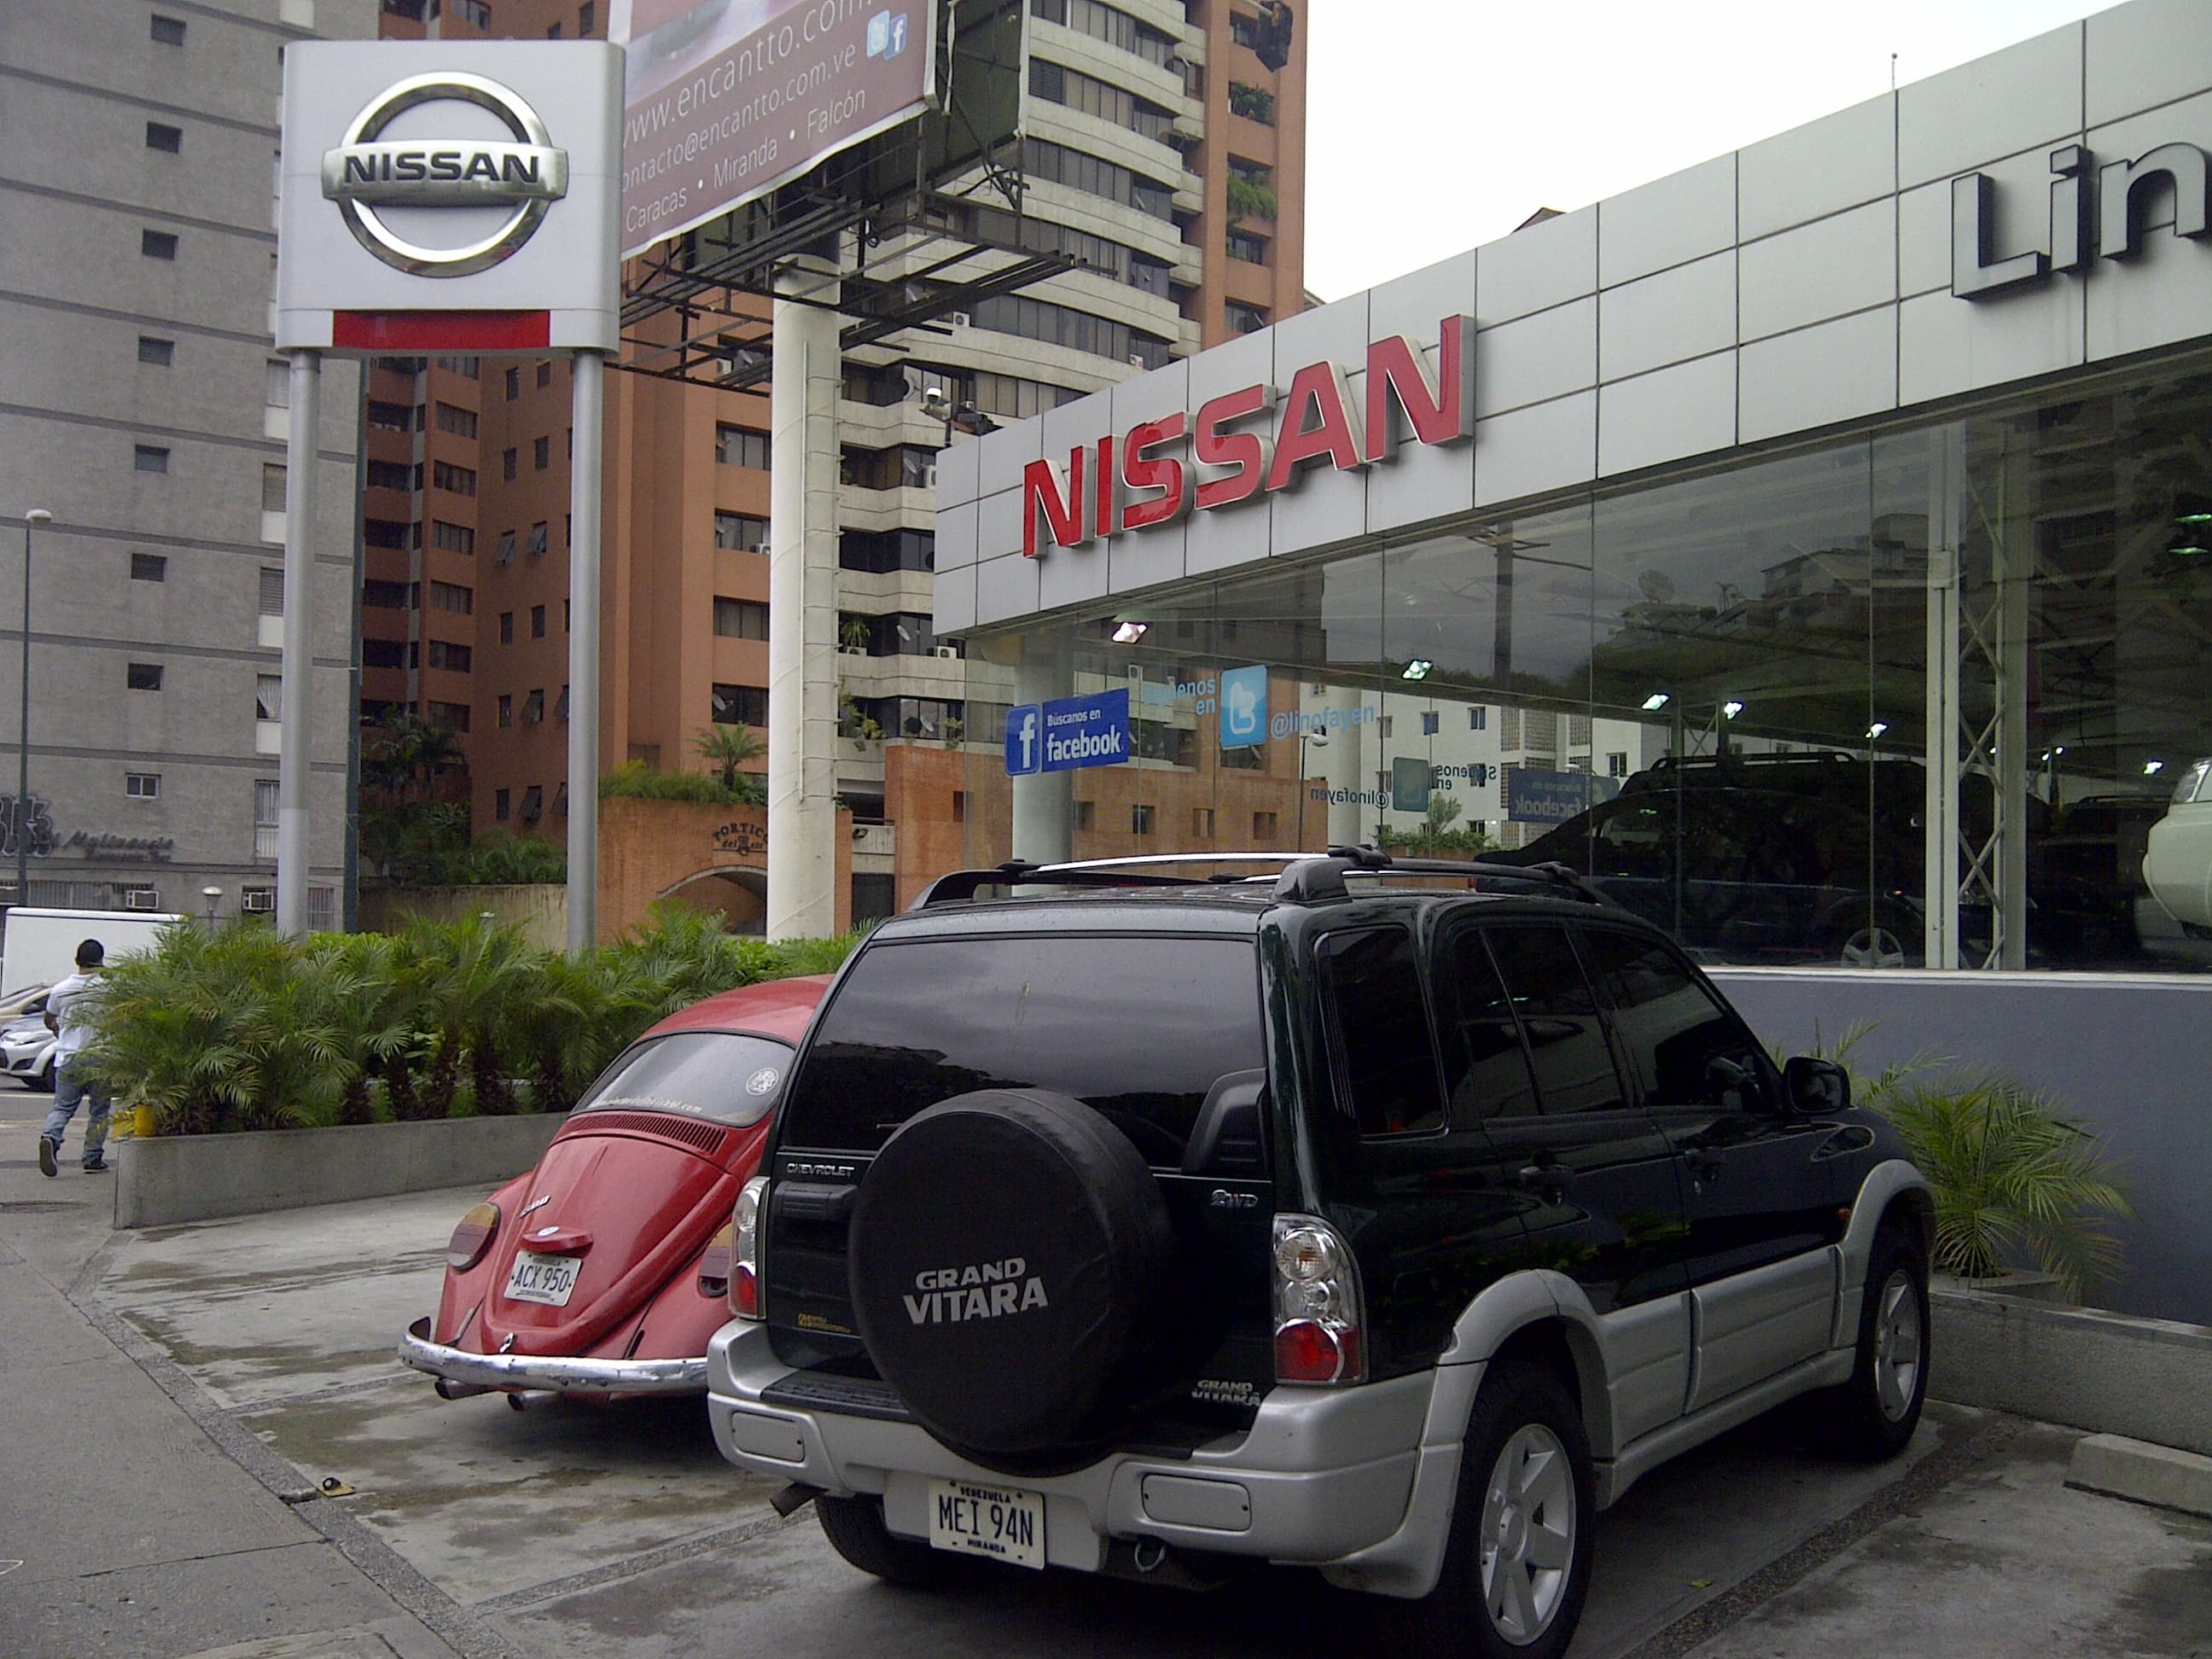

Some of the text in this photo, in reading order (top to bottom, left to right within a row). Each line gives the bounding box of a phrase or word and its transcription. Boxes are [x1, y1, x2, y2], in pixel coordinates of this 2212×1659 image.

[344, 152, 539, 184] NISSAN
[626, 89, 865, 232] Caracas Miranda Falcón
[1023, 313, 1474, 559] NISSAN
[1089, 708, 1101, 720] en
[1196, 698, 1216, 716] en
[1270, 703, 1376, 740] @linofayen
[1046, 724, 1121, 762] facebook
[787, 1162, 855, 1178] CHEVROLET
[514, 1264, 571, 1293] ACX 950
[915, 1257, 1027, 1291] GRAND
[902, 1276, 1049, 1325] VITARA
[1197, 1379, 1254, 1393] GRAND
[939, 1494, 1033, 1547] MEI 94N
[967, 1538, 1006, 1554] MIRANDA
